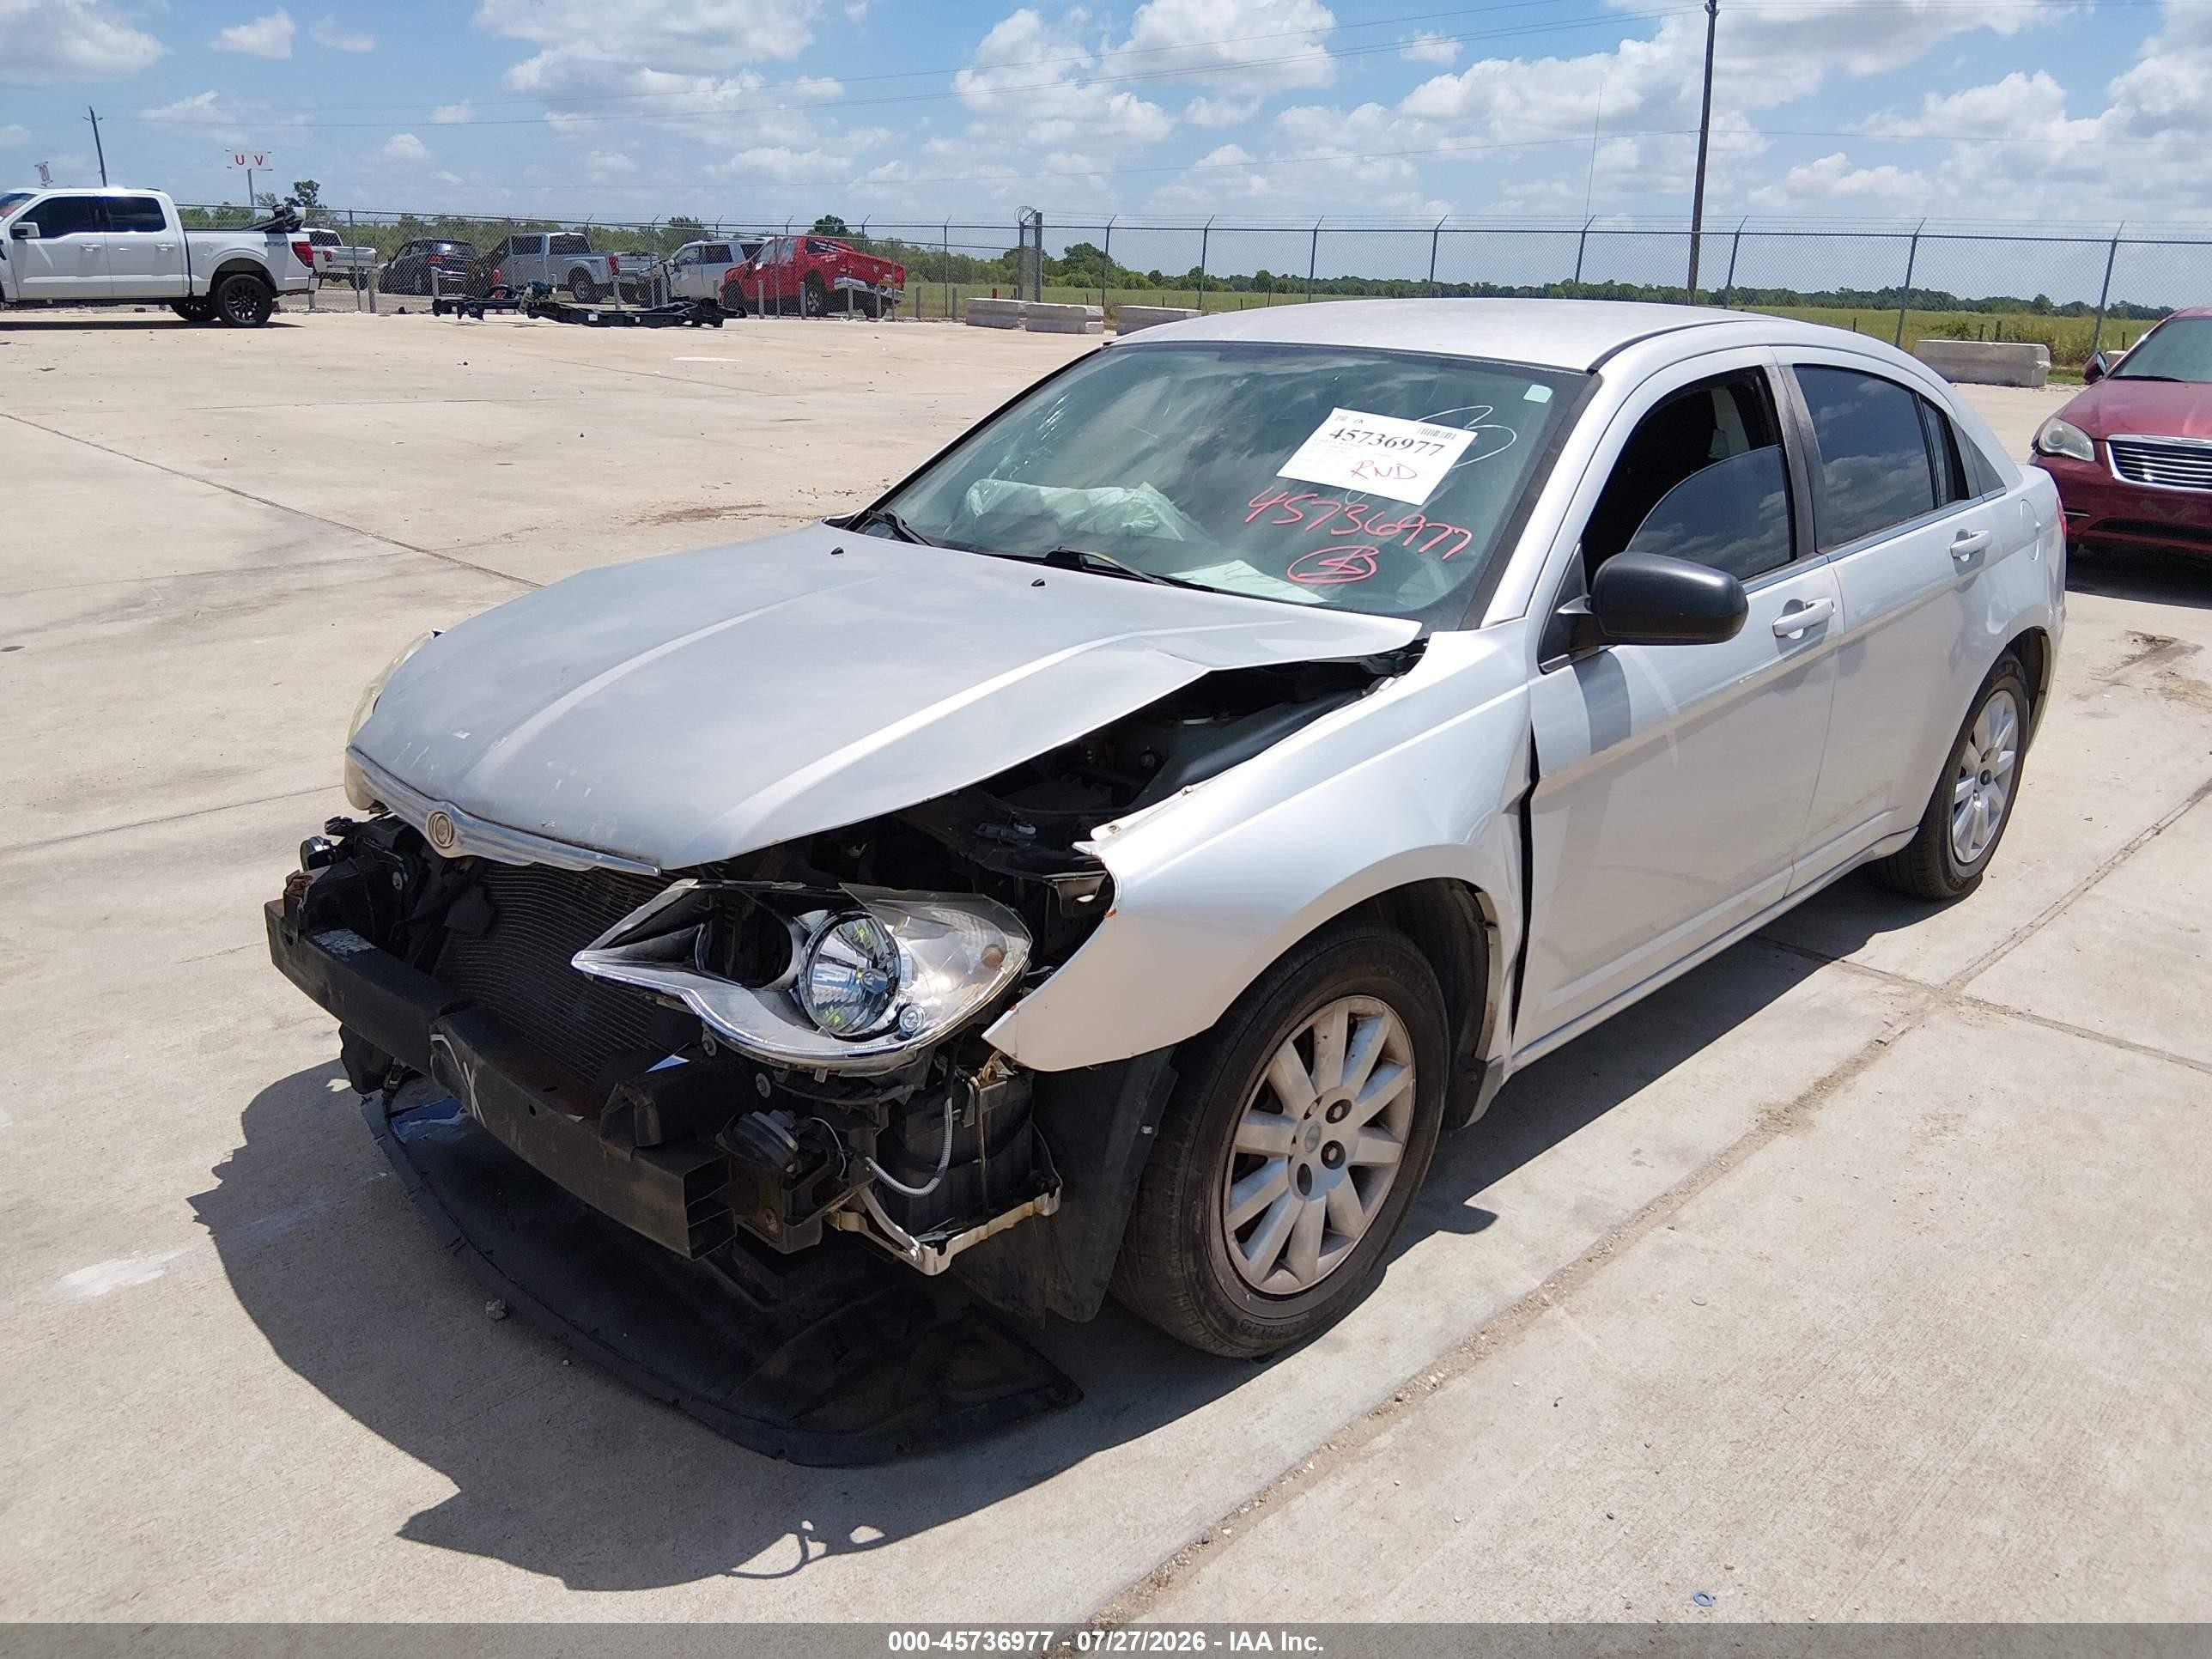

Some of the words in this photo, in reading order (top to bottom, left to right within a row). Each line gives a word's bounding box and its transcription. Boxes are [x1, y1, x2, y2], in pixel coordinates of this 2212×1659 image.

[234, 155, 245, 166] U
[254, 155, 264, 166] V
[1328, 428, 1446, 457] 45736977
[1349, 459, 1419, 481] RND
[1245, 486, 1473, 561] 45736977
